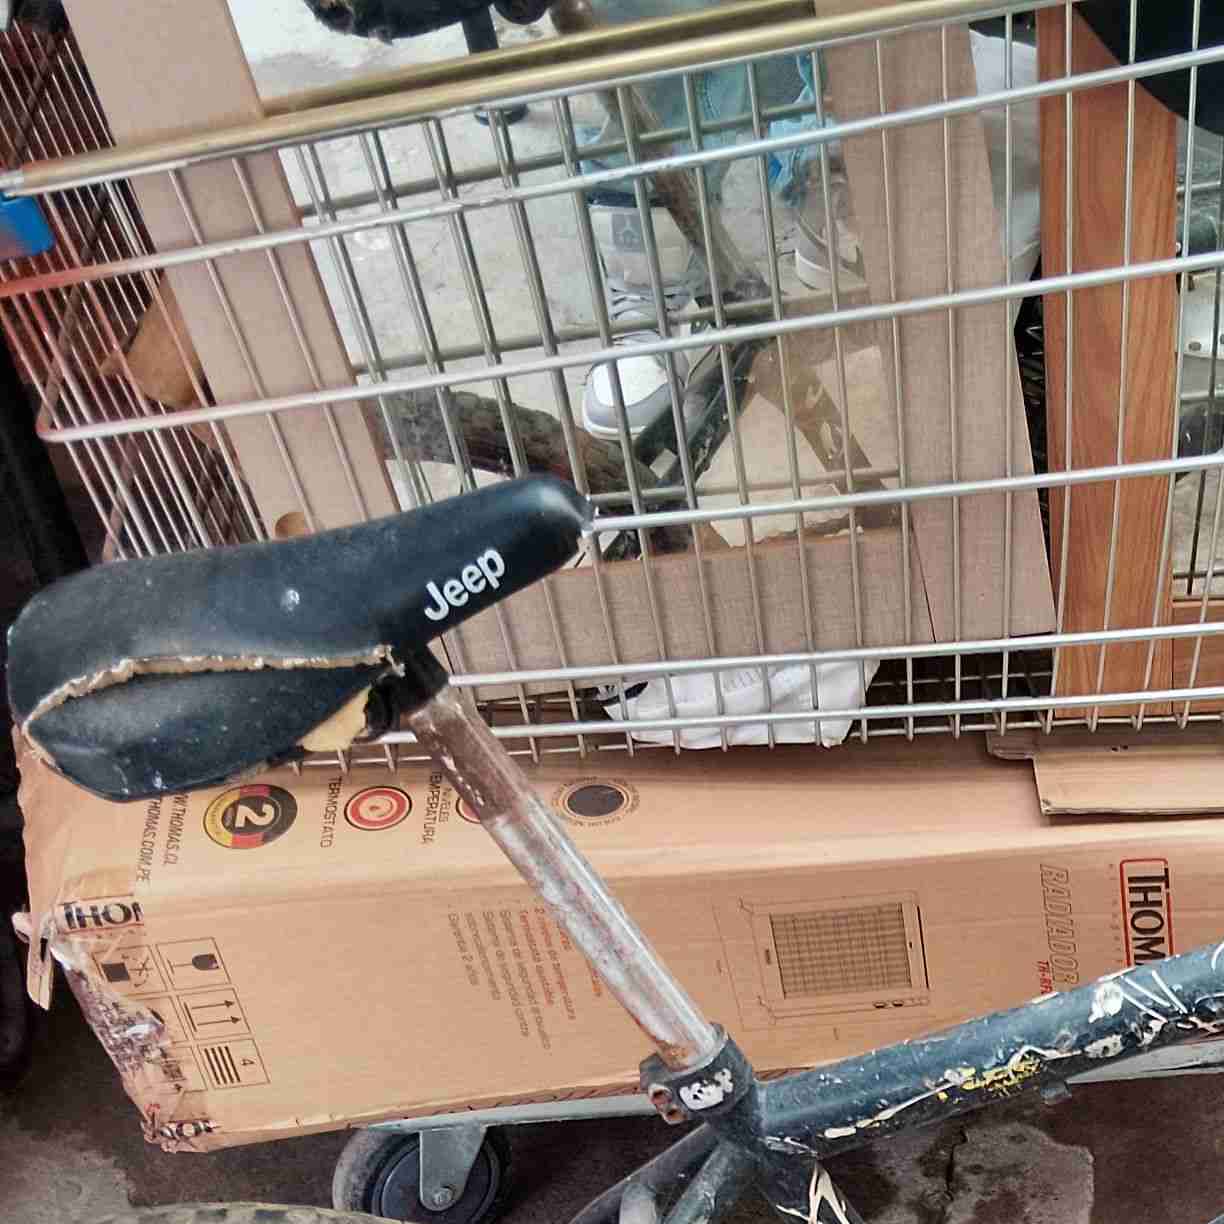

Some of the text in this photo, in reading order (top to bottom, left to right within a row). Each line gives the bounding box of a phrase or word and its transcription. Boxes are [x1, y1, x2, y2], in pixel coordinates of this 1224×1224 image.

[424, 549, 506, 621] Jeep
[235, 804, 276, 829] 2
[319, 775, 344, 849] TERMOSTATO
[1040, 864, 1080, 985] RADIADOR
[1128, 867, 1170, 966] THOM
